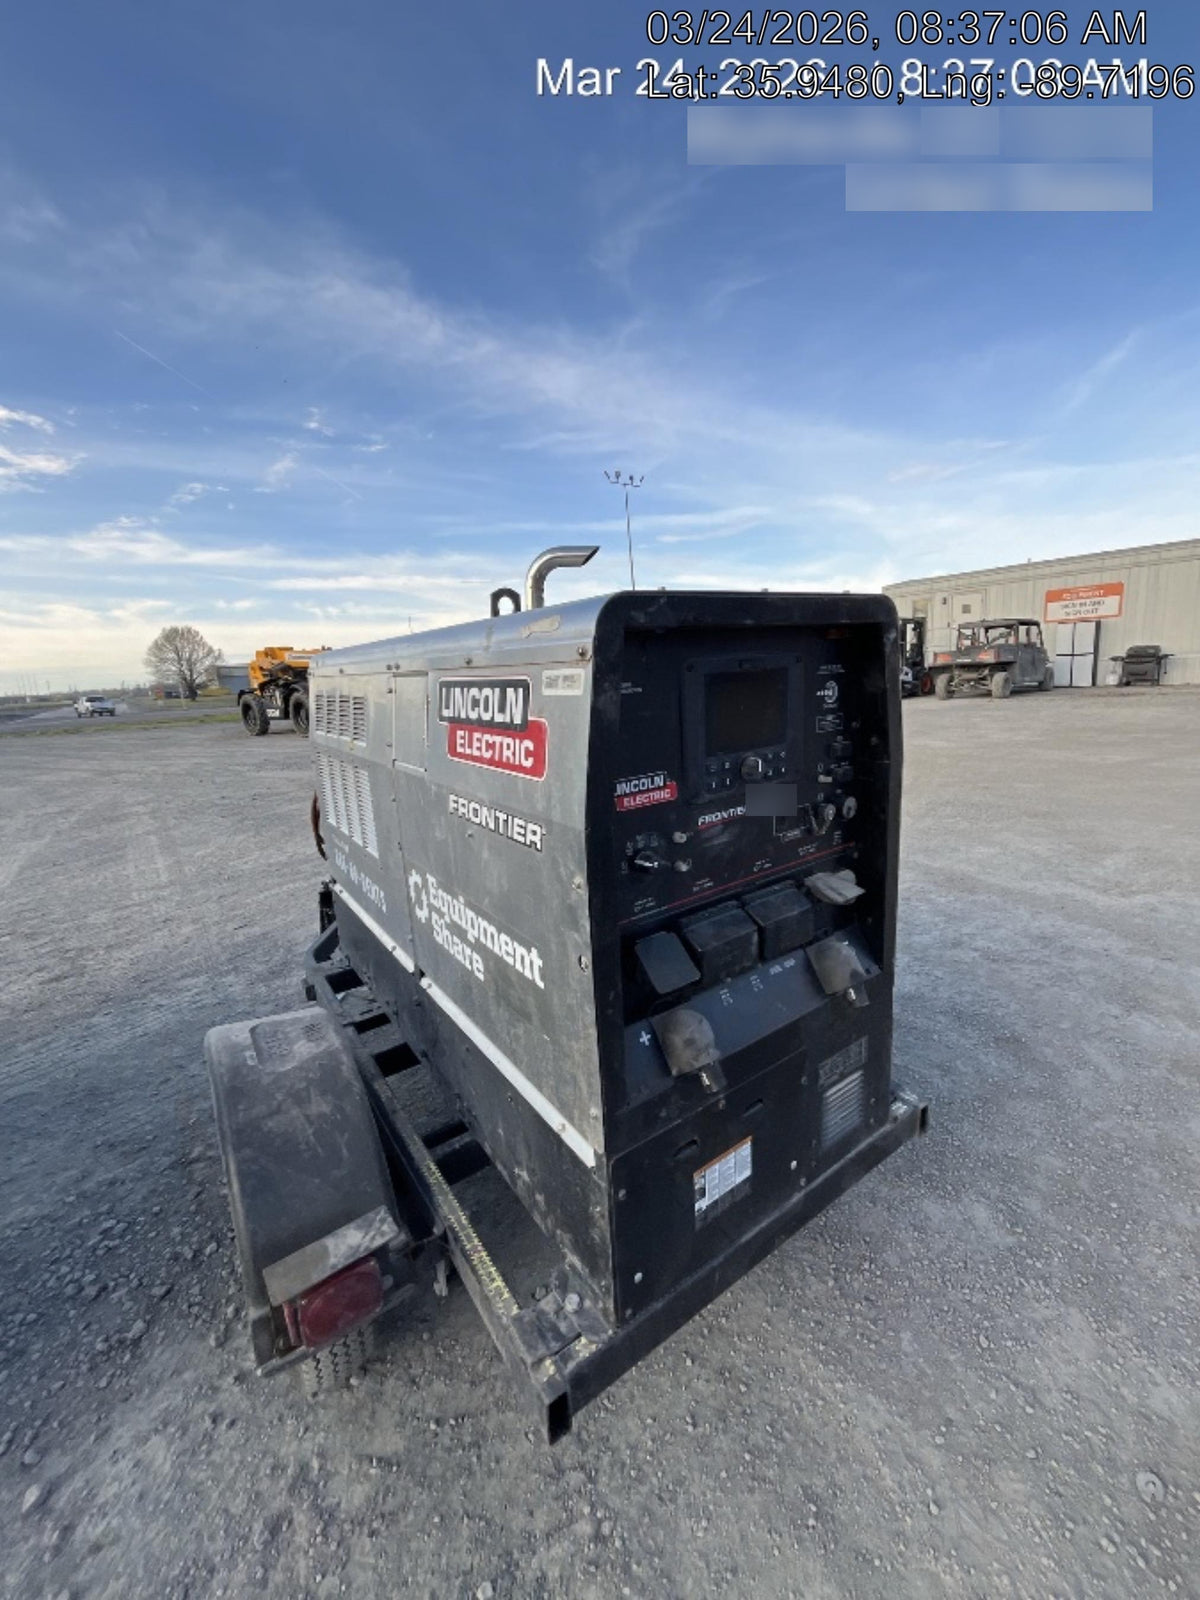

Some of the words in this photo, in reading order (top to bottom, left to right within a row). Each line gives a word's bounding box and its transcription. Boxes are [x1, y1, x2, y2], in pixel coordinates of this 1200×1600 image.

[441, 686, 524, 726] LINCOLN
[456, 729, 534, 768] ELECTRIC
[623, 788, 671, 808] ELECTRIC
[698, 805, 748, 826] FRONTIE
[449, 794, 543, 851] FRONTIER
[426, 872, 545, 989] Equipment
[431, 911, 484, 982] Share
